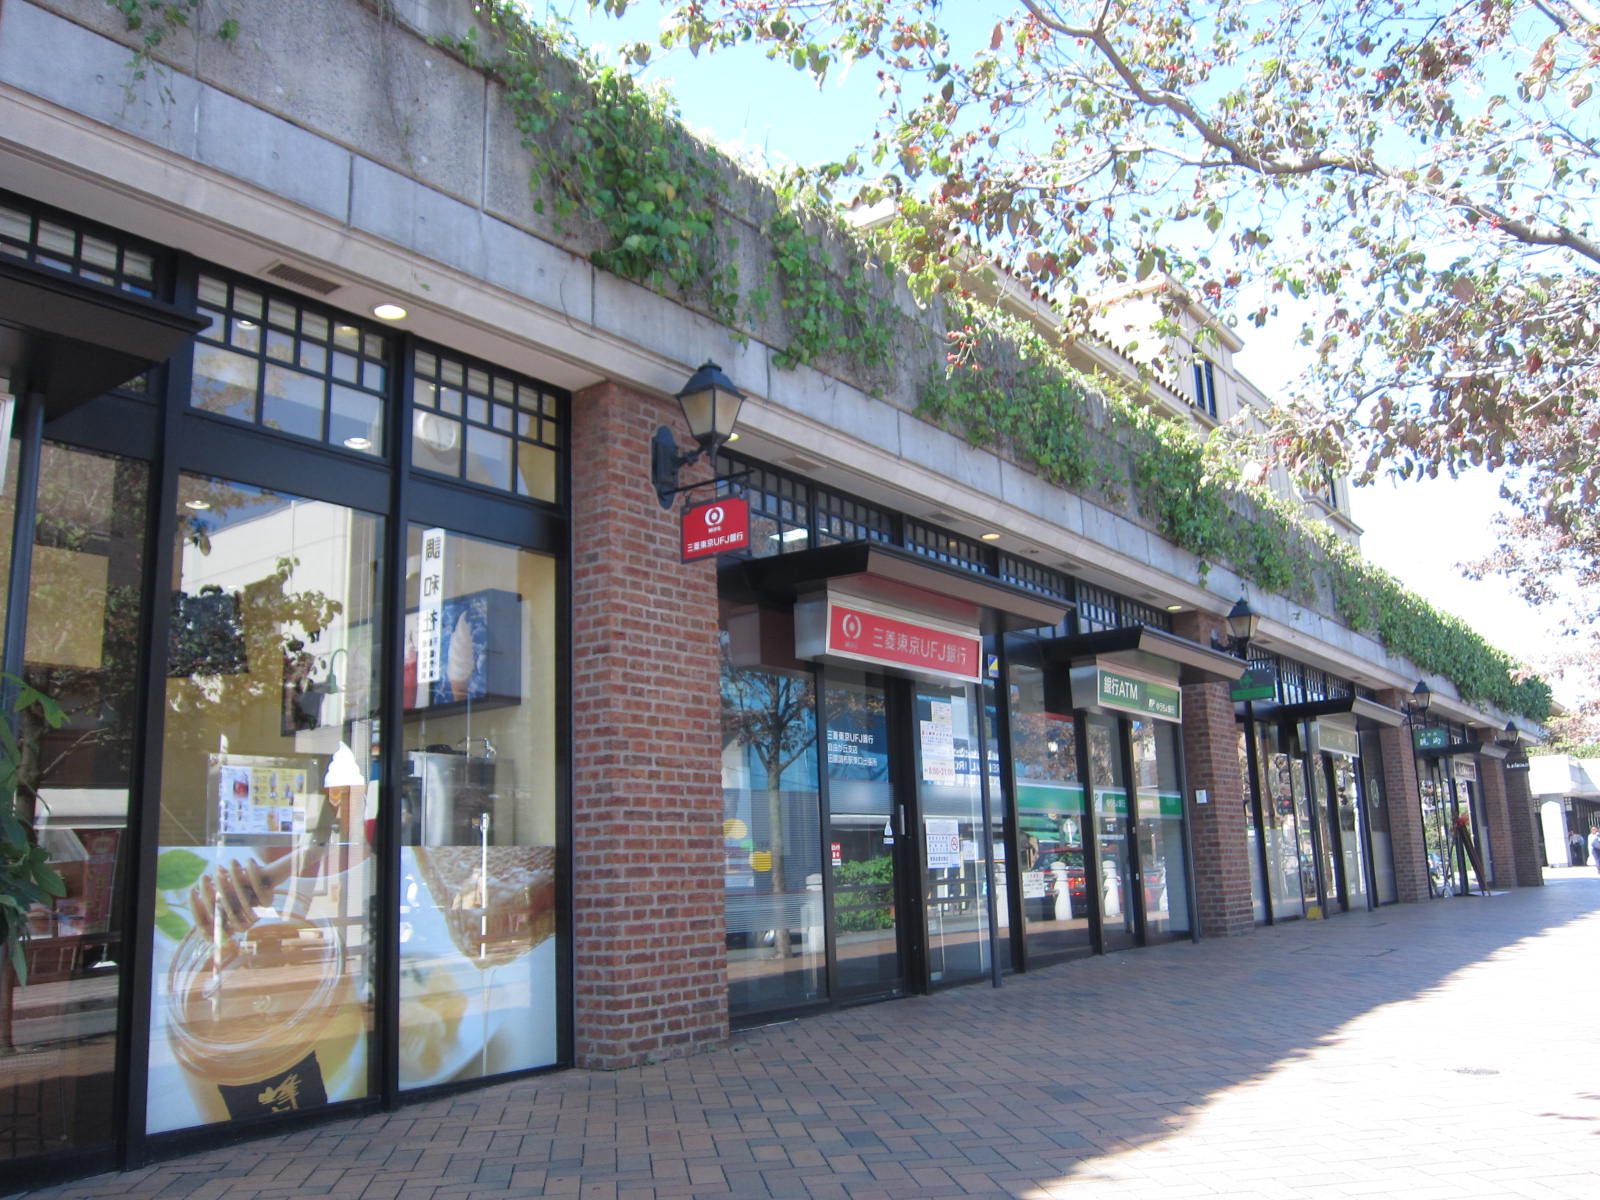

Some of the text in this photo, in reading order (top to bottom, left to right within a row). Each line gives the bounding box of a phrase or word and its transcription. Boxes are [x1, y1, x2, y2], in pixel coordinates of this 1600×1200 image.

[687, 531, 743, 552] 三菱東京UFJ銀行
[873, 627, 967, 665] 三菱東京UFJ銀行
[1104, 676, 1138, 701] 銀行ATM
[827, 730, 874, 744] 三菱東京UFJ銀行
